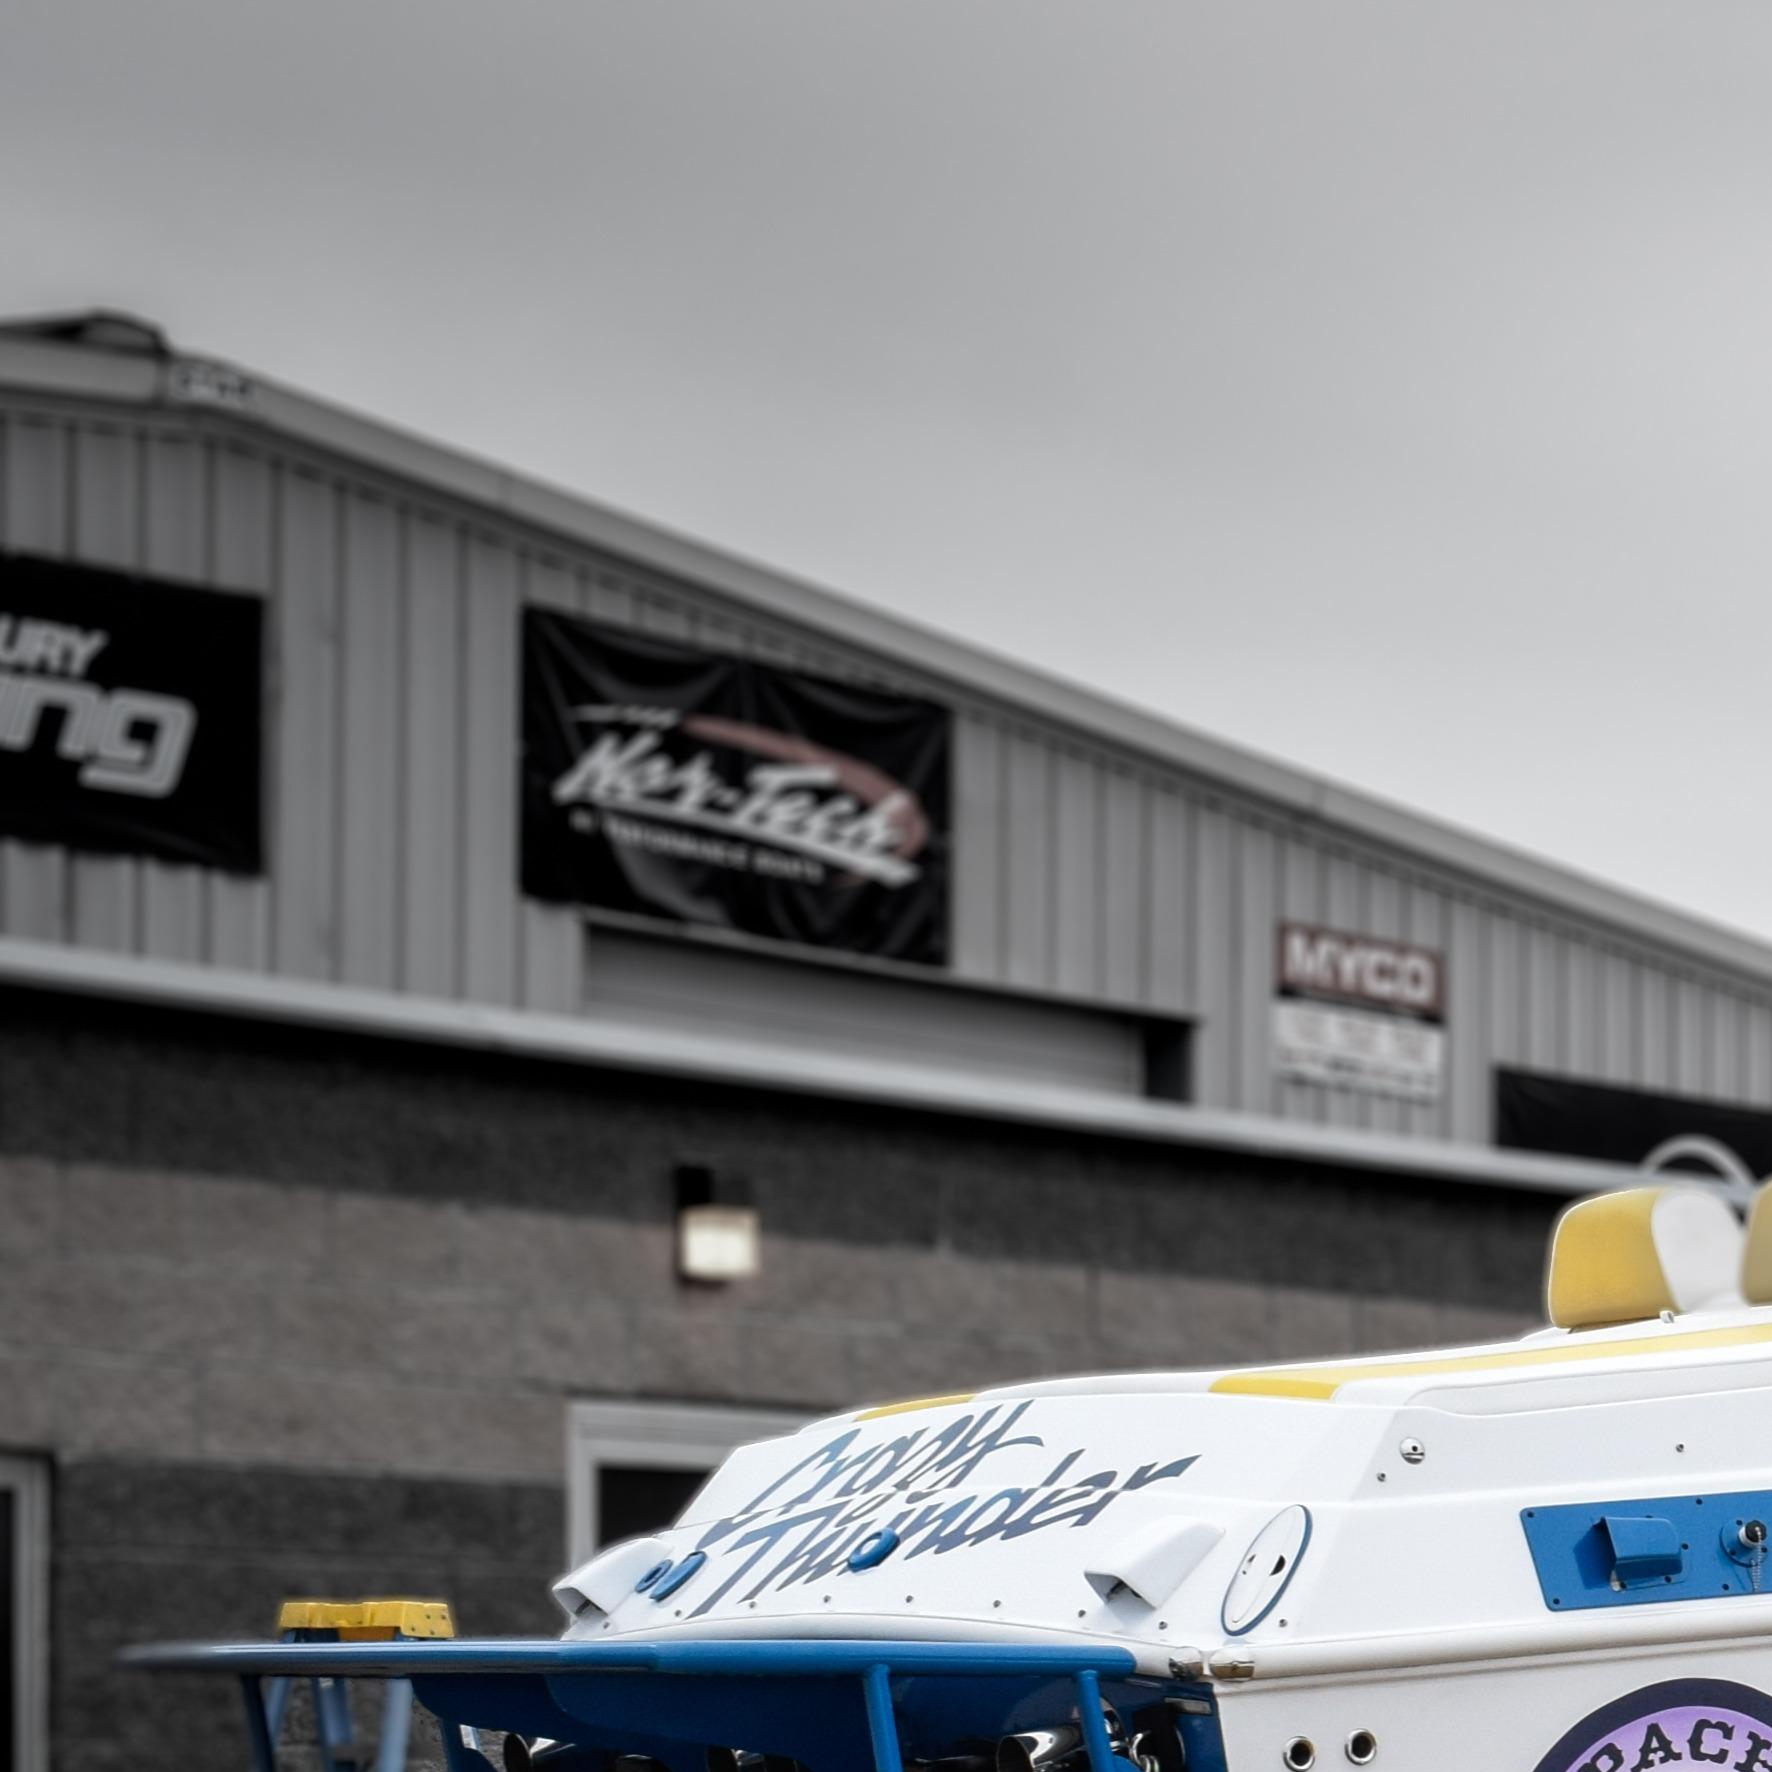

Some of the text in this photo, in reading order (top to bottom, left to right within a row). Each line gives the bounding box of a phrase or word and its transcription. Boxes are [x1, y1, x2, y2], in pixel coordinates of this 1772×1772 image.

[1284, 931, 1436, 1004] MYCO
[687, 1449, 1202, 1619] Thunder
[695, 1399, 1044, 1549] Crazy
